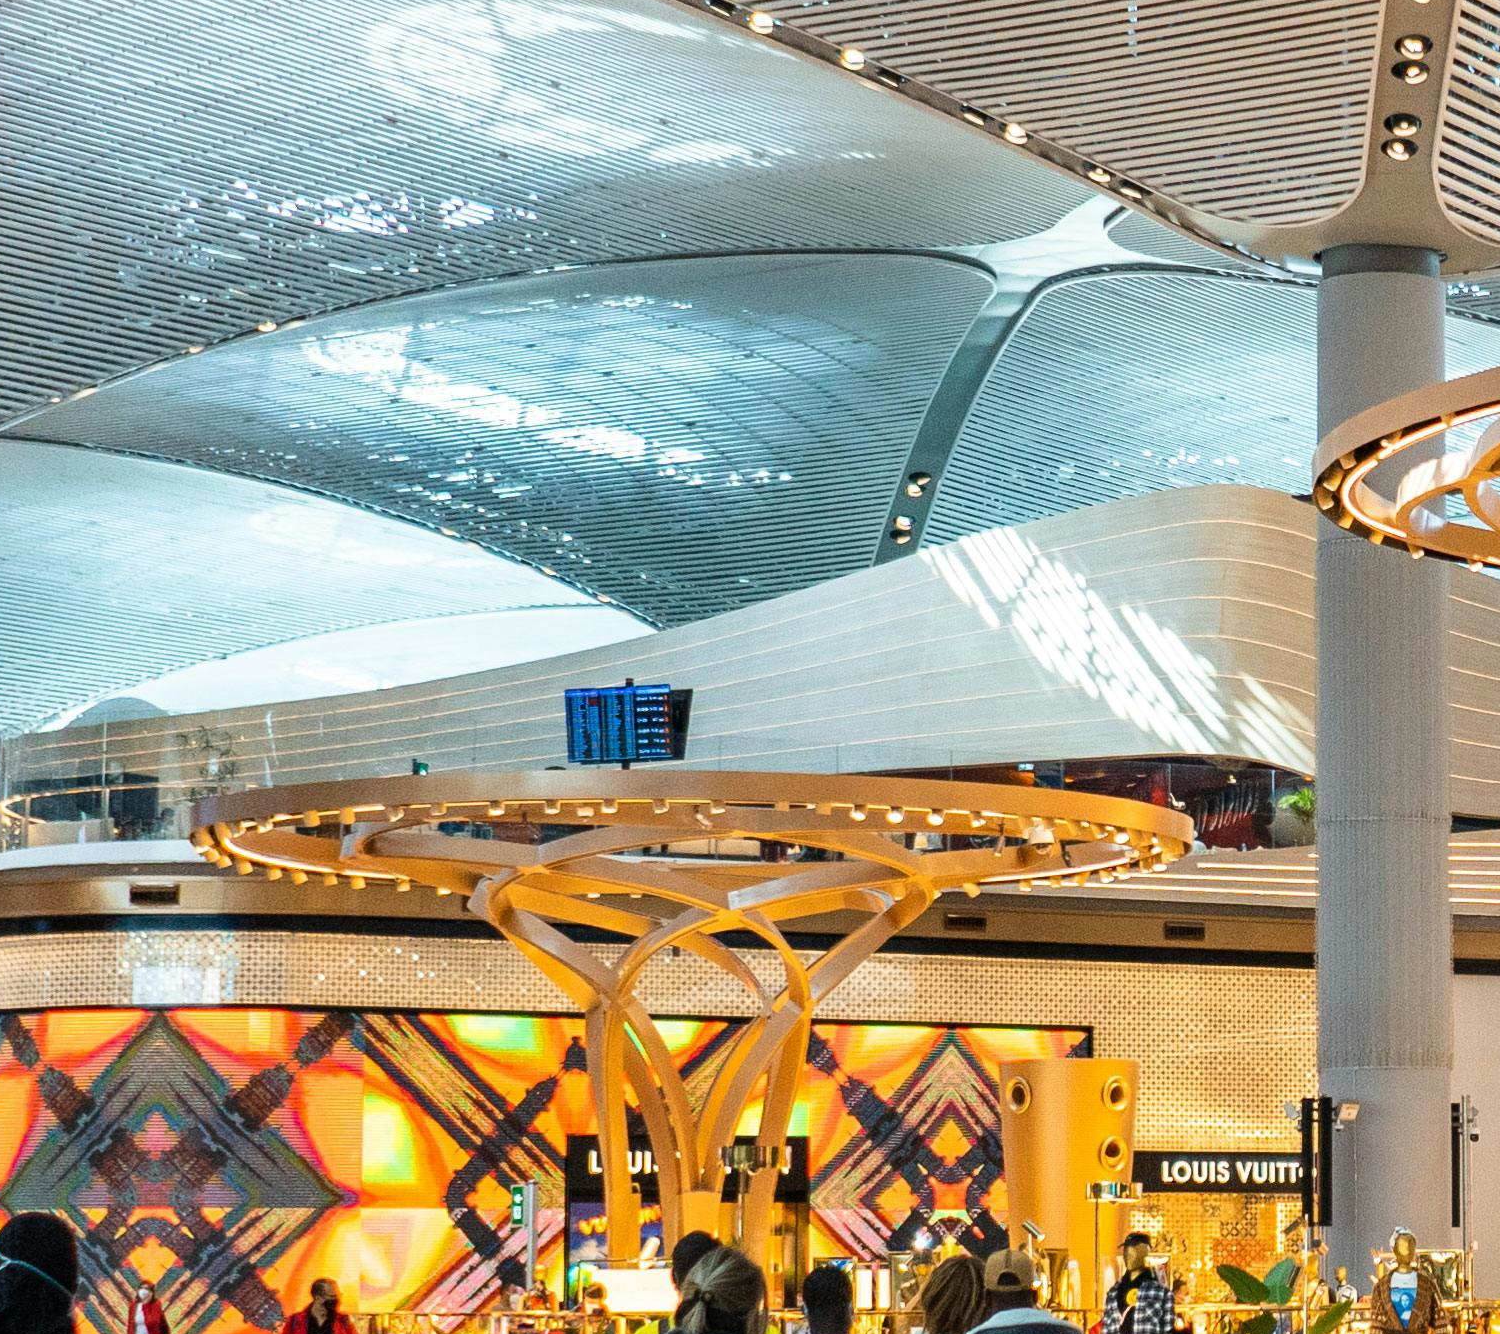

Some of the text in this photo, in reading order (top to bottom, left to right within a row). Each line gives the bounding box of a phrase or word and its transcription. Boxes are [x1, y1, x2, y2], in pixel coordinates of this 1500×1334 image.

[589, 1150, 660, 1175] LUI
[1161, 1160, 1318, 1185] LOUIS VUITT
